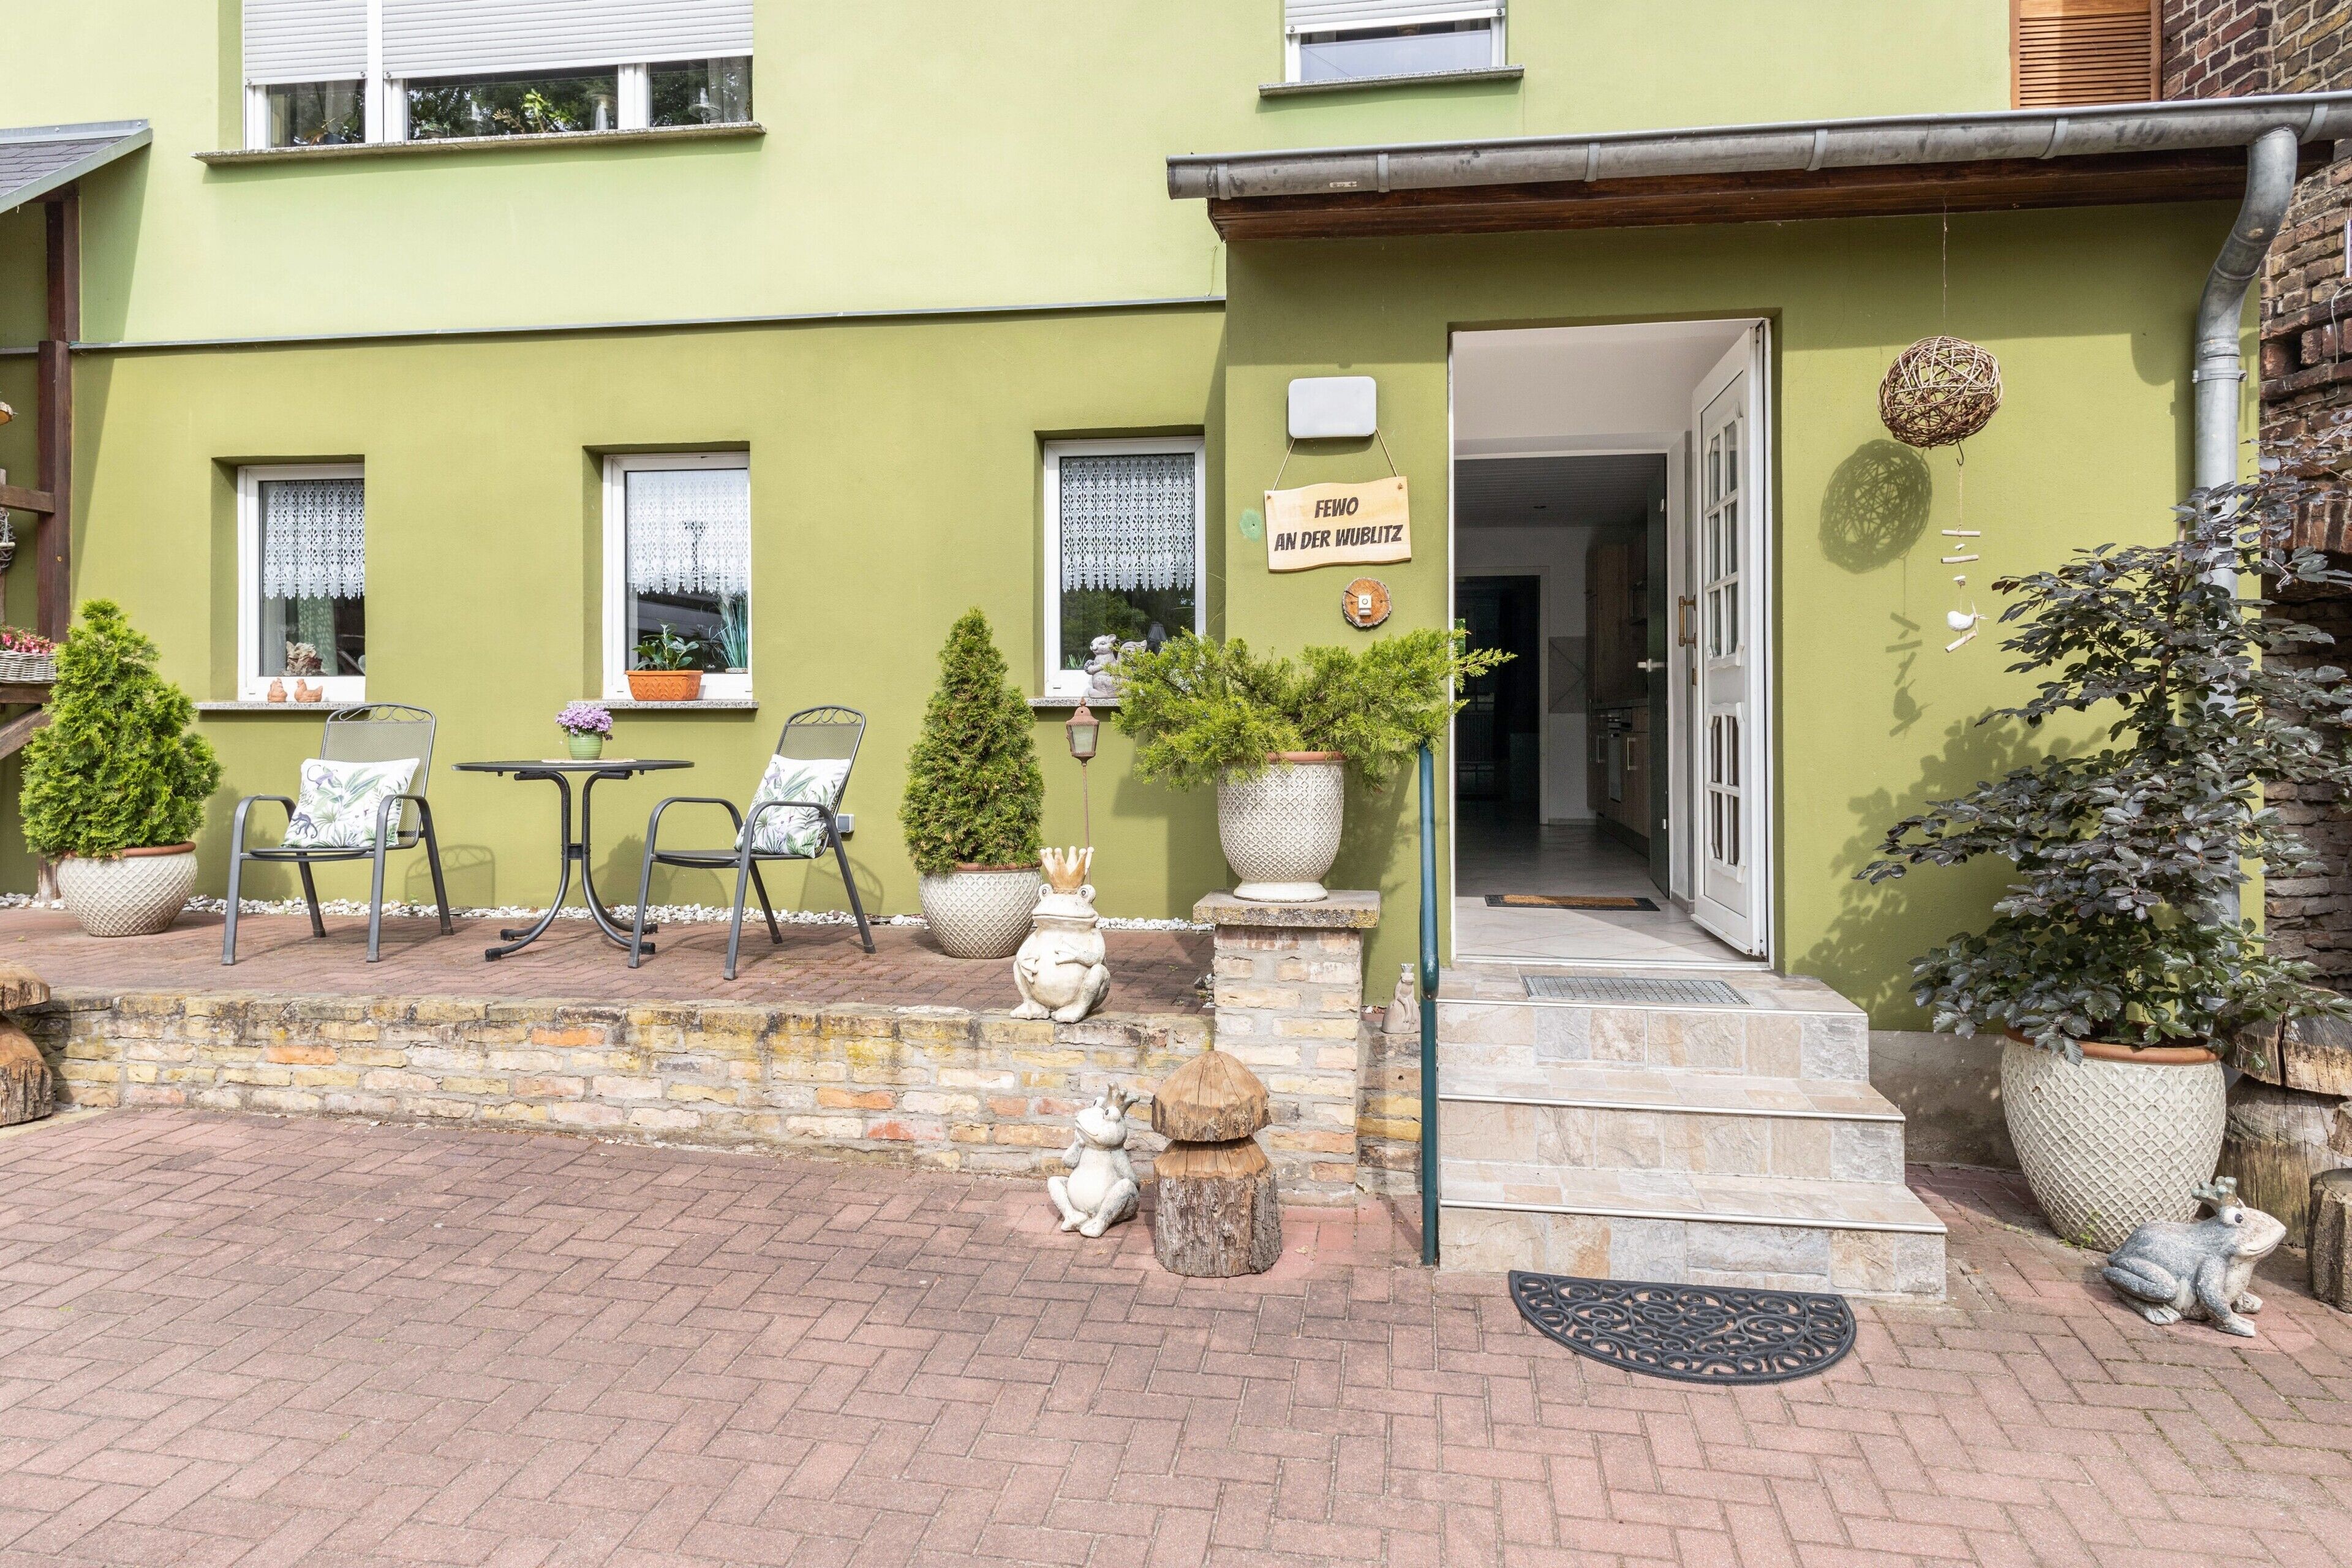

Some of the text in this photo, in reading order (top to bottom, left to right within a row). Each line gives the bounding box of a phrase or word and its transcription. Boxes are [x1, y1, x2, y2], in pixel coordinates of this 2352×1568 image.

[1314, 497, 1359, 518] FEWO
[1274, 524, 1403, 551] AN DER WUBLITZ
